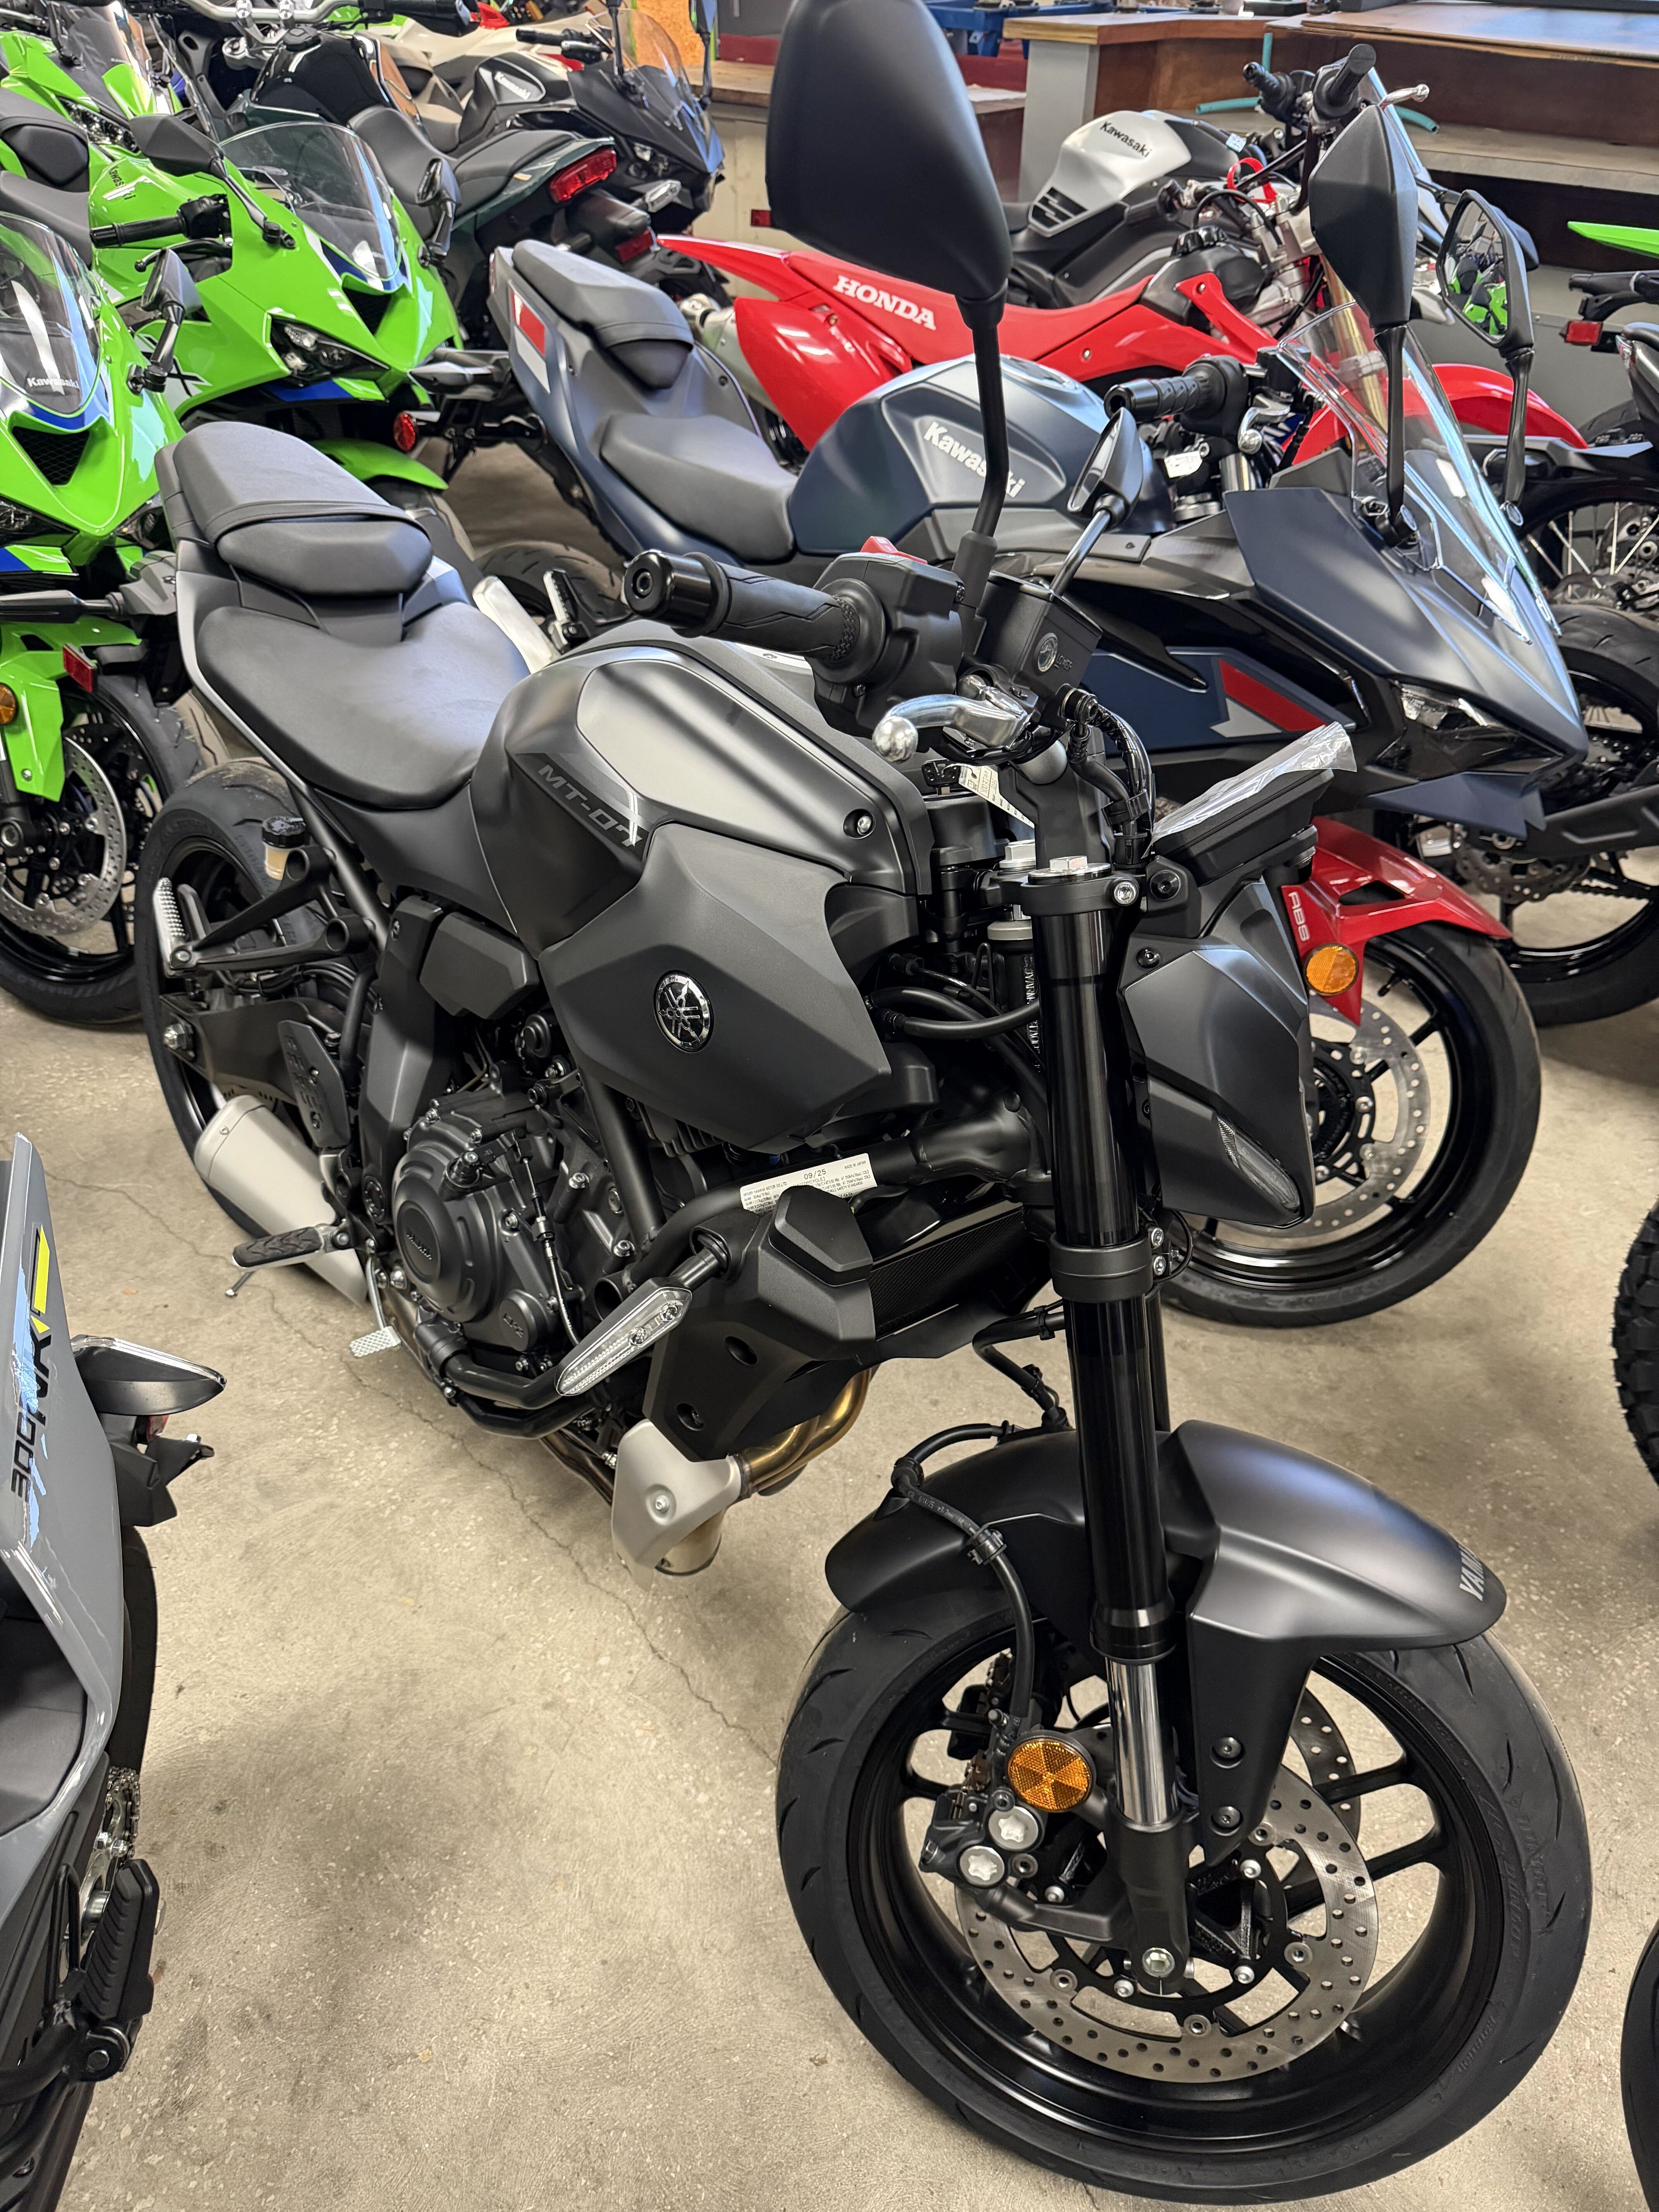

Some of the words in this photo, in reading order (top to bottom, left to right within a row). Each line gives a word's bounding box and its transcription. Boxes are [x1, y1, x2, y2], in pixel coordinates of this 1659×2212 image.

[1099, 121, 1152, 158] Kawasaki
[109, 165, 136, 200] Kawasi
[833, 275, 937, 331] HONDA
[27, 377, 80, 390] Kawsaki
[924, 422, 1026, 498] Kawaski
[538, 764, 643, 847] MT-07
[1288, 891, 1311, 942] ABS
[804, 1168, 826, 1180] 09/25
